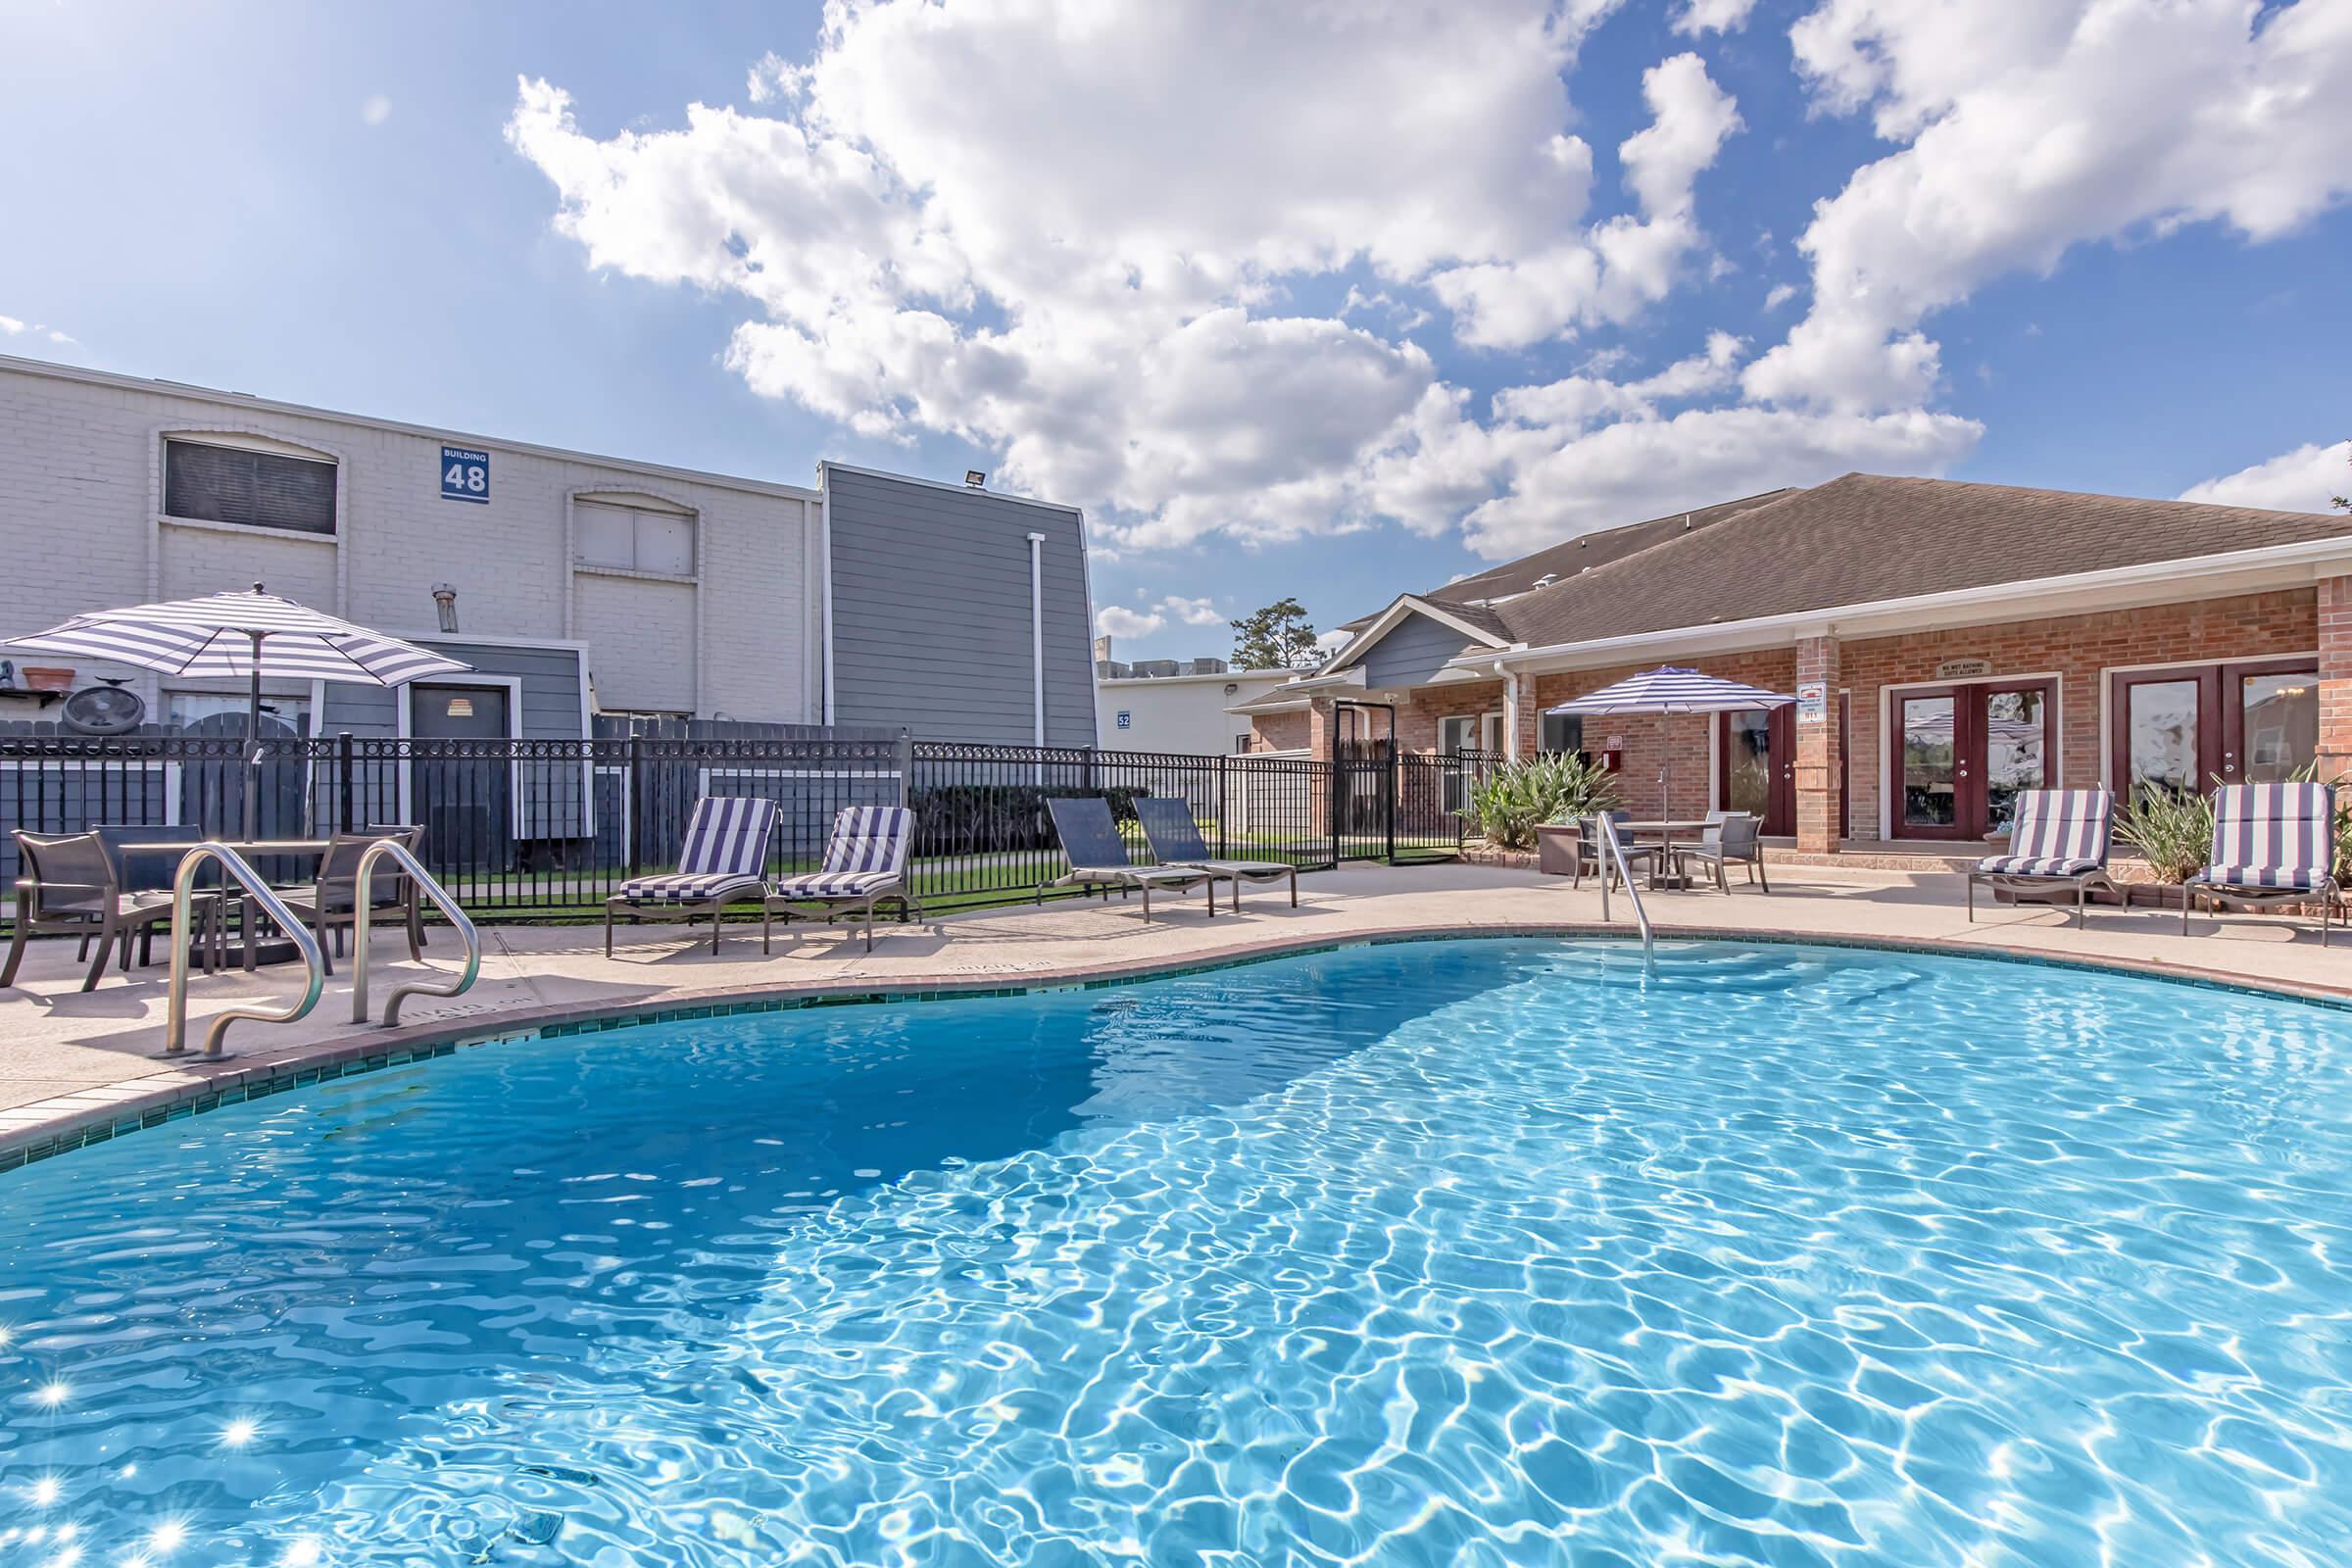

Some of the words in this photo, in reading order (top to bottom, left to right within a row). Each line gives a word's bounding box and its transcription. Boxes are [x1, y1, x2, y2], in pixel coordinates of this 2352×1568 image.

[444, 449, 487, 462] BUILDING
[445, 464, 486, 492] 48
[1118, 715, 1130, 725] 52
